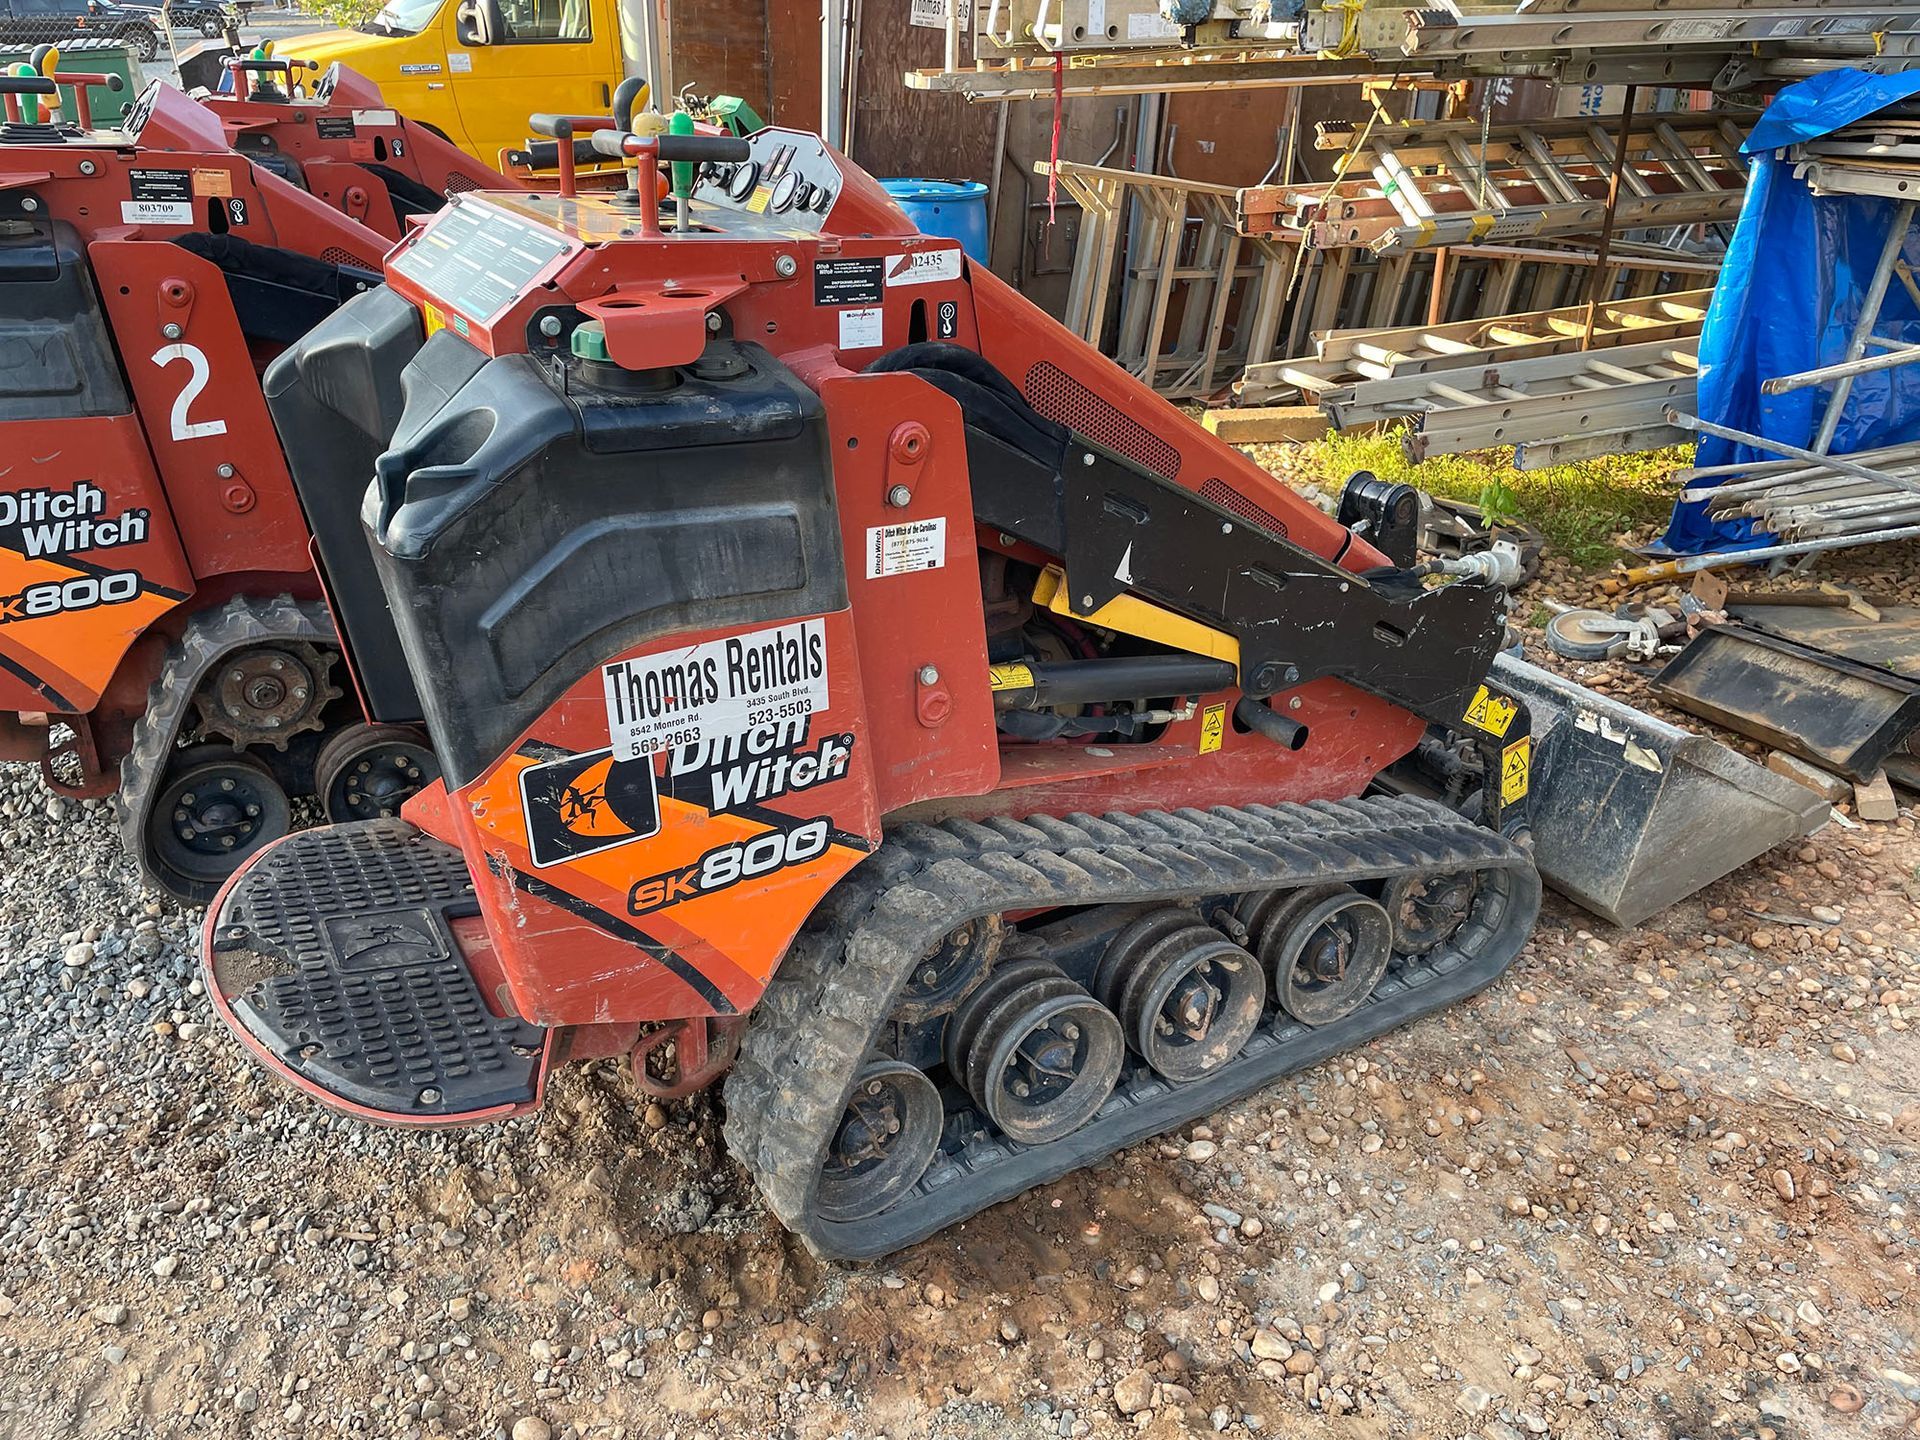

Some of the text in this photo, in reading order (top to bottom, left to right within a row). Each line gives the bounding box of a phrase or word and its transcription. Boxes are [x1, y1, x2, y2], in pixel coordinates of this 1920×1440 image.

[138, 203, 174, 213] 803709
[151, 343, 227, 441] 2
[606, 623, 823, 725] Thomas Rentals
[746, 685, 812, 708] 3435 South Blvd.
[630, 712, 702, 737] 8542 Monroe Rd.
[749, 698, 812, 727] 523-5503
[634, 820, 828, 911] SK800
